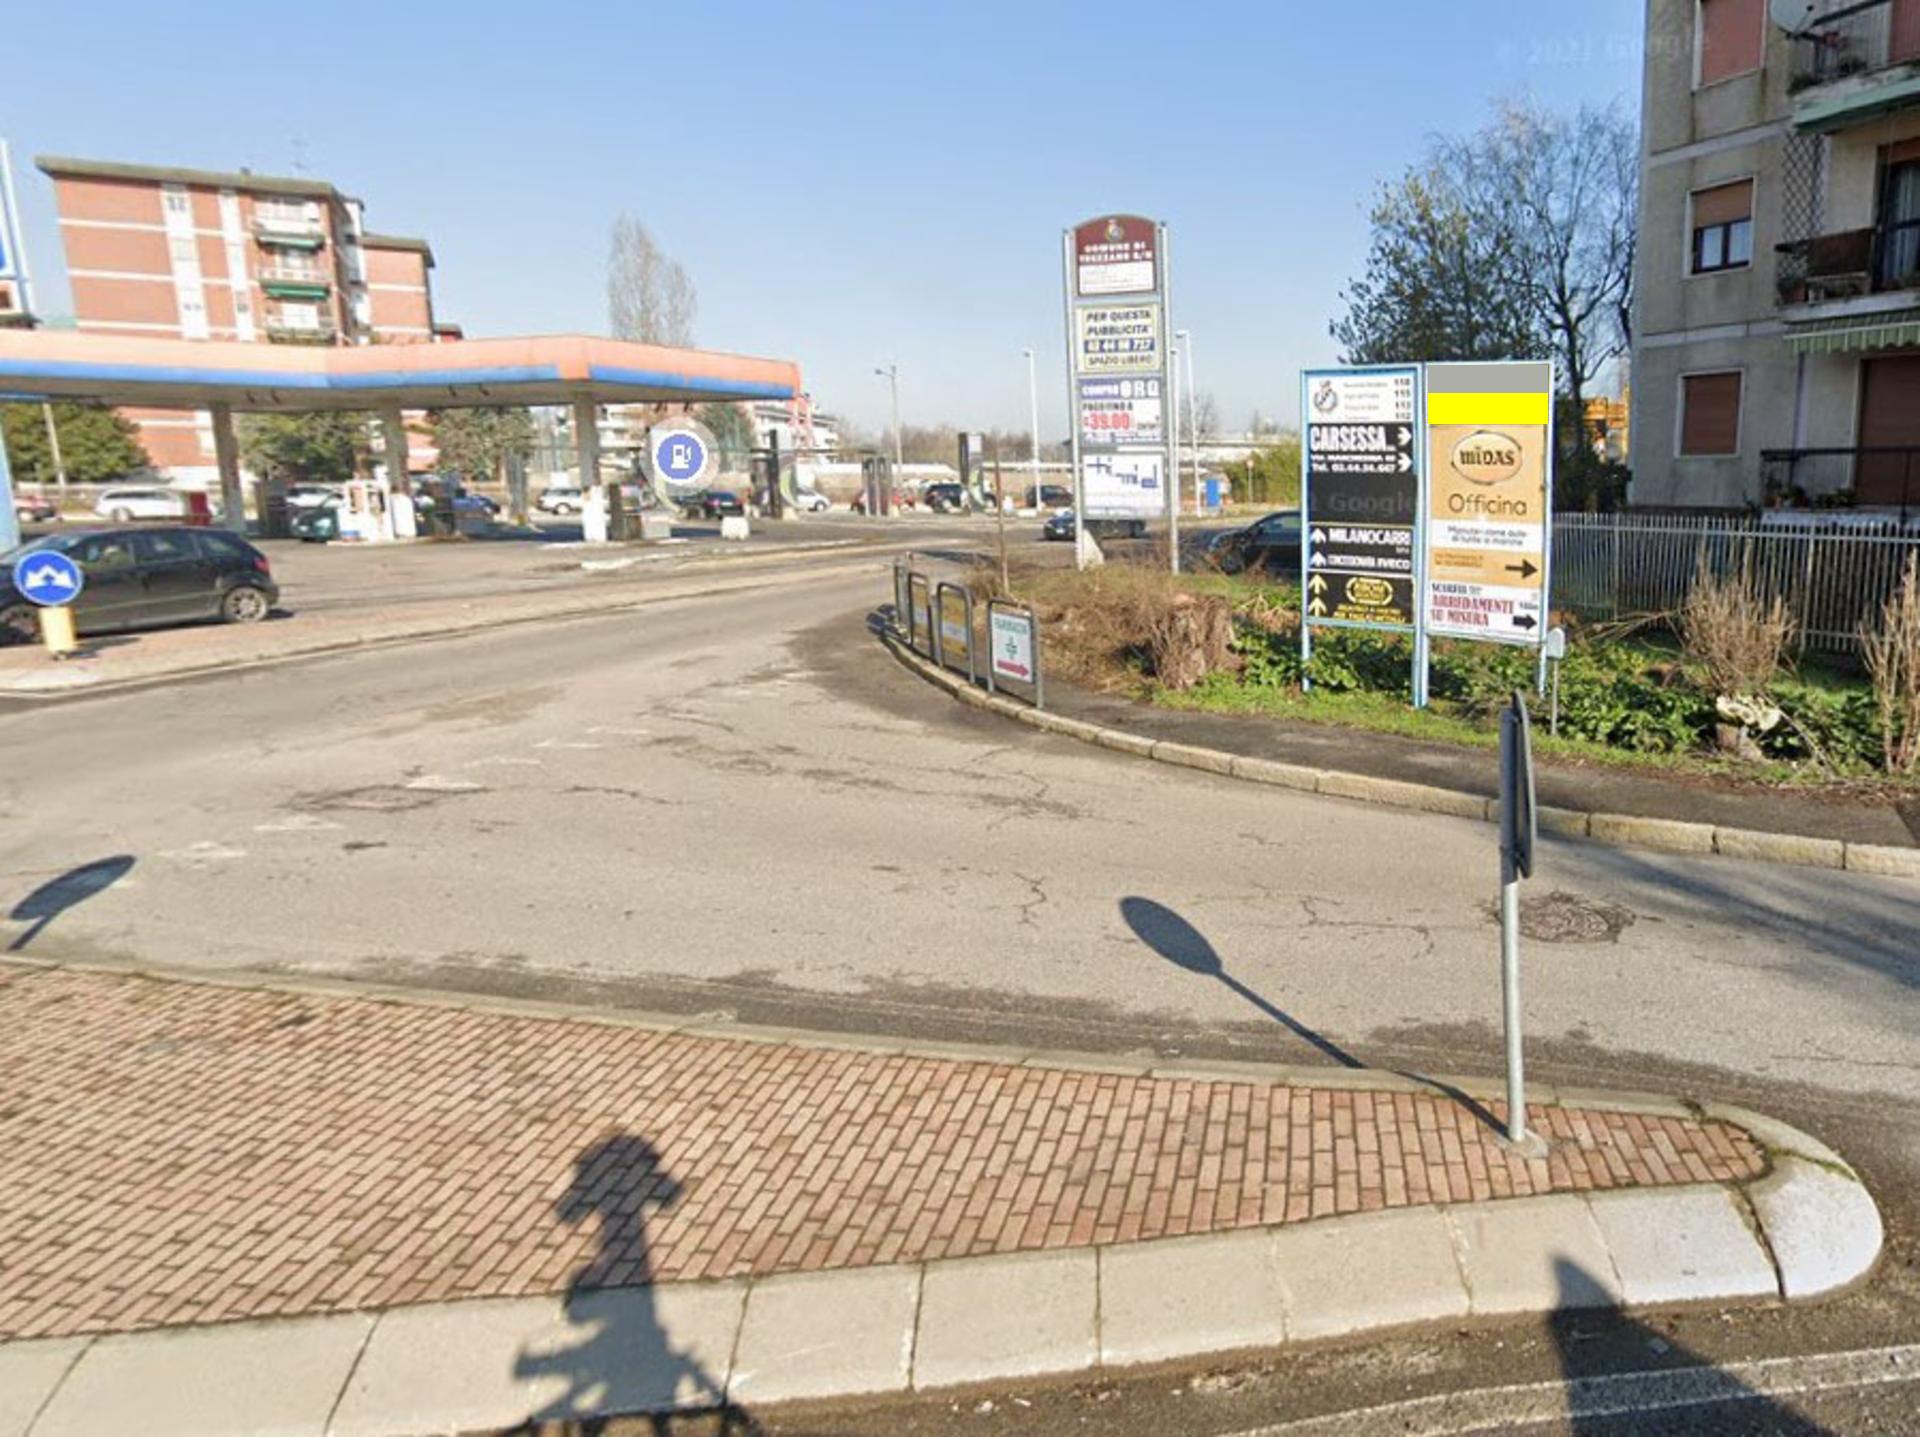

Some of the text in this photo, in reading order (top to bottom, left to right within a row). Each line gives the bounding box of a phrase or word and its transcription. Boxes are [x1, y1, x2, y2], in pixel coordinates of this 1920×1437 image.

[1086, 310, 1151, 321] PER QUESTA
[1088, 354, 1154, 365] SPAZIO LIBERO
[1120, 380, 1160, 398] ORO
[1310, 425, 1386, 452] CARSESSA
[1448, 493, 1527, 516] Officina
[1329, 527, 1411, 546] MILANOCARRI
[1376, 557, 1411, 570] IVECO
